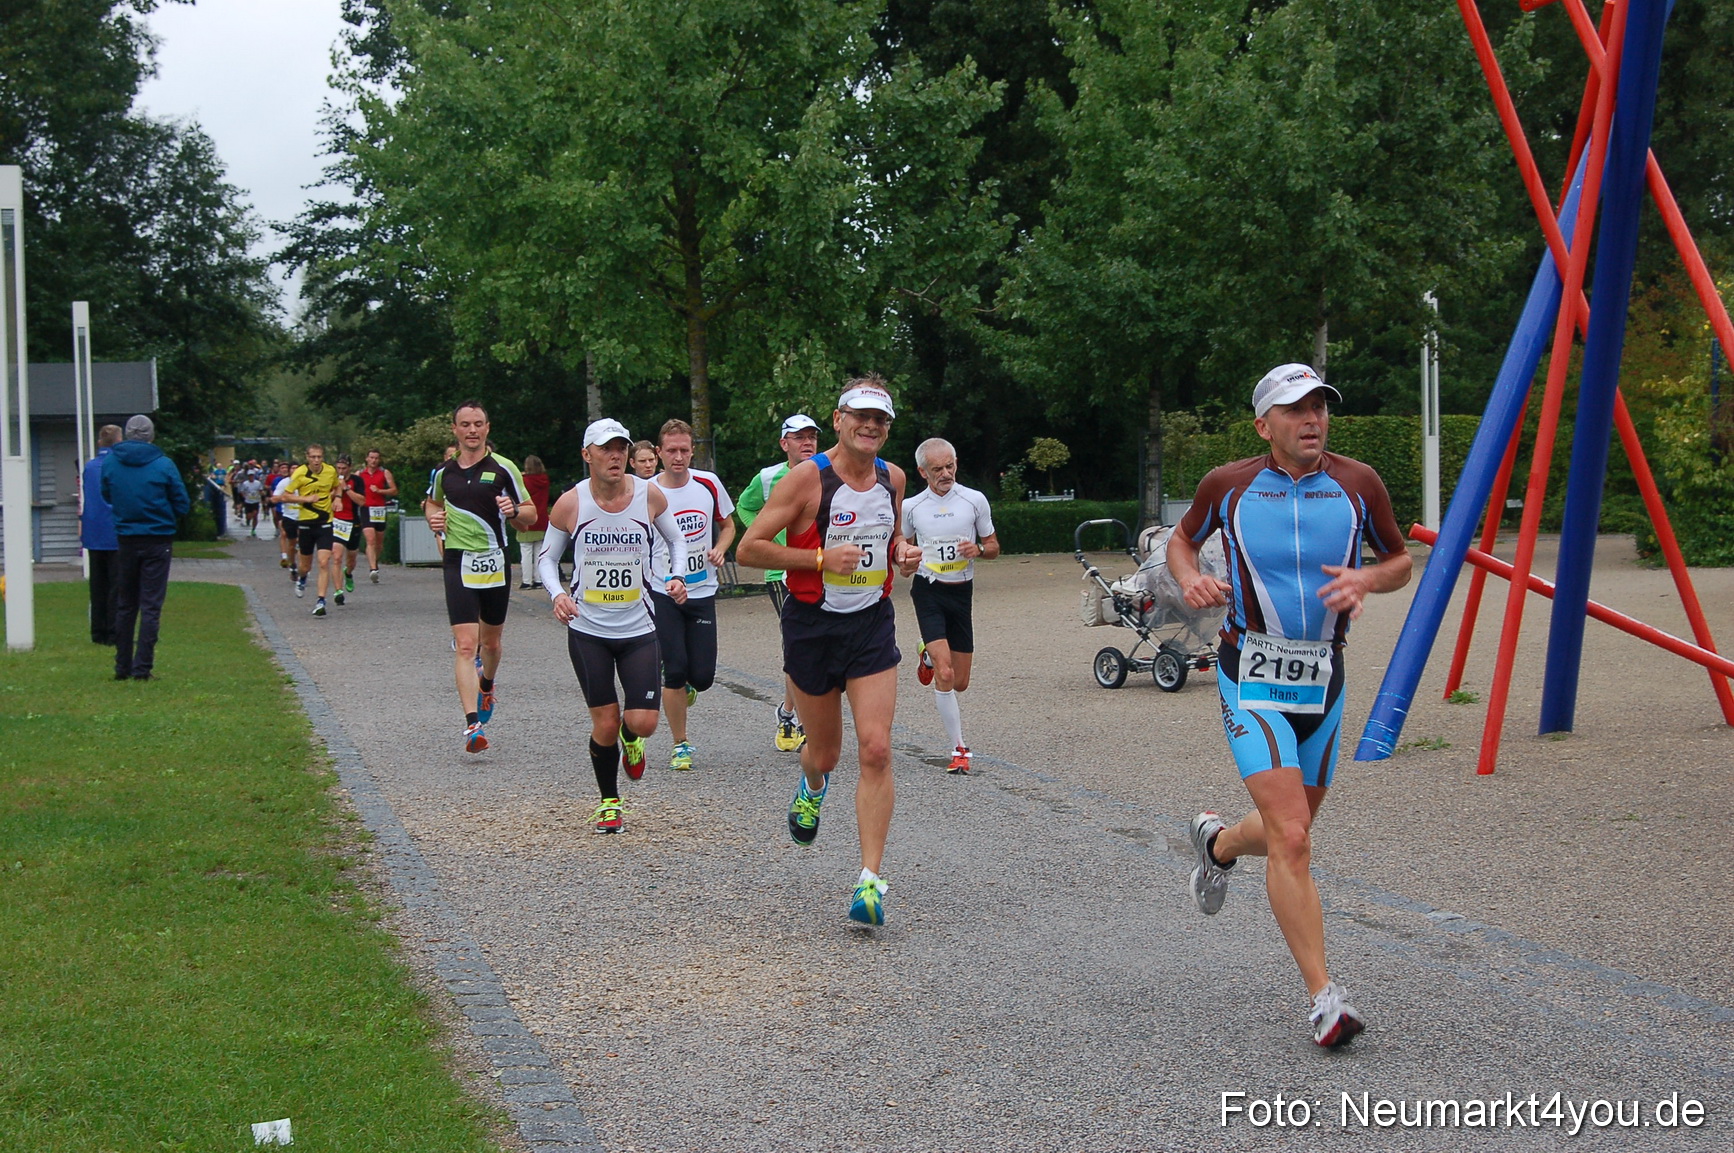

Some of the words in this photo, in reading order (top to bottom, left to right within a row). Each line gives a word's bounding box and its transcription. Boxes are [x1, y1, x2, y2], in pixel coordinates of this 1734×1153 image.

[679, 522, 704, 531] ANIG
[584, 532, 642, 546] ERDINGER
[827, 533, 851, 541] PARTL
[853, 533, 881, 541] Neumarkt
[854, 544, 873, 568] 5
[937, 545, 956, 561] 13
[471, 559, 498, 573] 558
[596, 569, 632, 588] 286
[850, 574, 867, 584] Udo
[603, 593, 625, 601] Klaus
[1246, 636, 1274, 651] PARTL
[1276, 646, 1318, 657] Neumarkt
[1248, 651, 1320, 682] 2191
[1269, 687, 1299, 701] Hans
